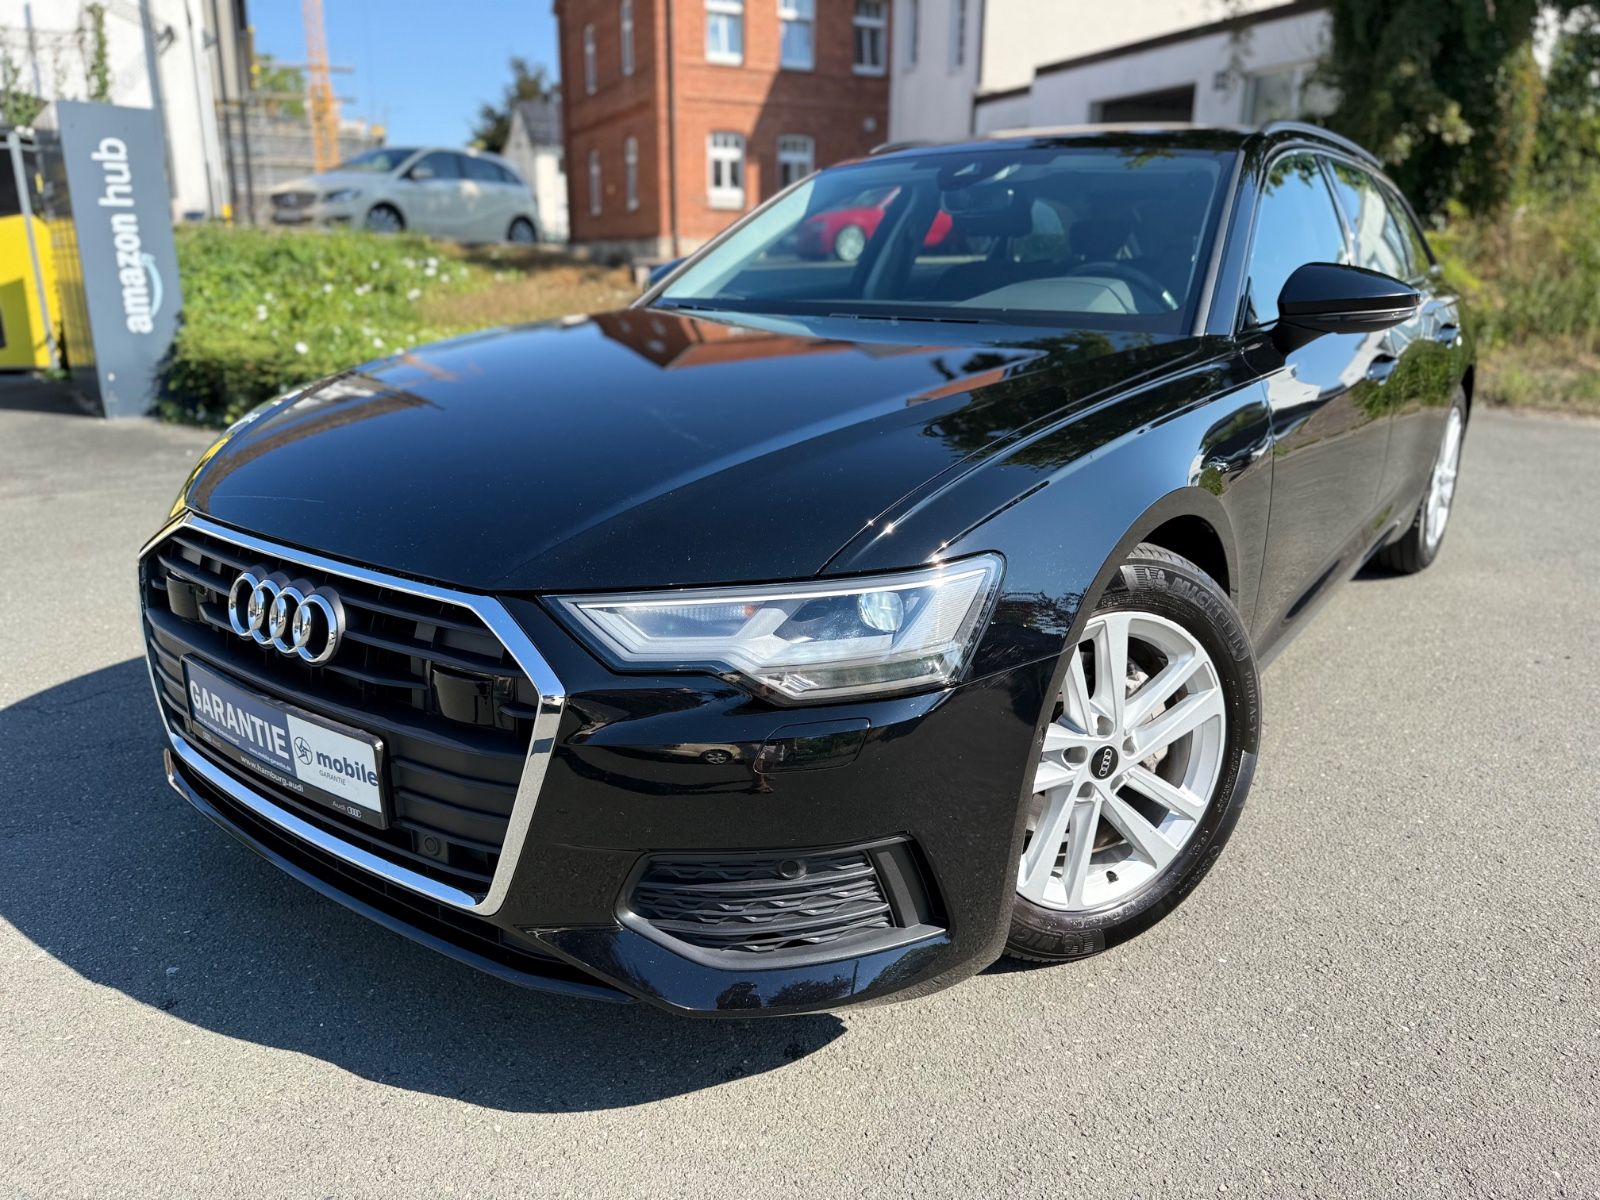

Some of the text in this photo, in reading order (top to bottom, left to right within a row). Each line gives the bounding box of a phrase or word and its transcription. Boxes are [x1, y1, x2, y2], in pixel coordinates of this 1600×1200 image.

[91, 137, 154, 334] amazon hub
[1171, 576, 1247, 653] MICHELIN
[189, 679, 290, 760] GARANTIE
[316, 751, 379, 786] mobile
[319, 769, 346, 786] GARANTIE
